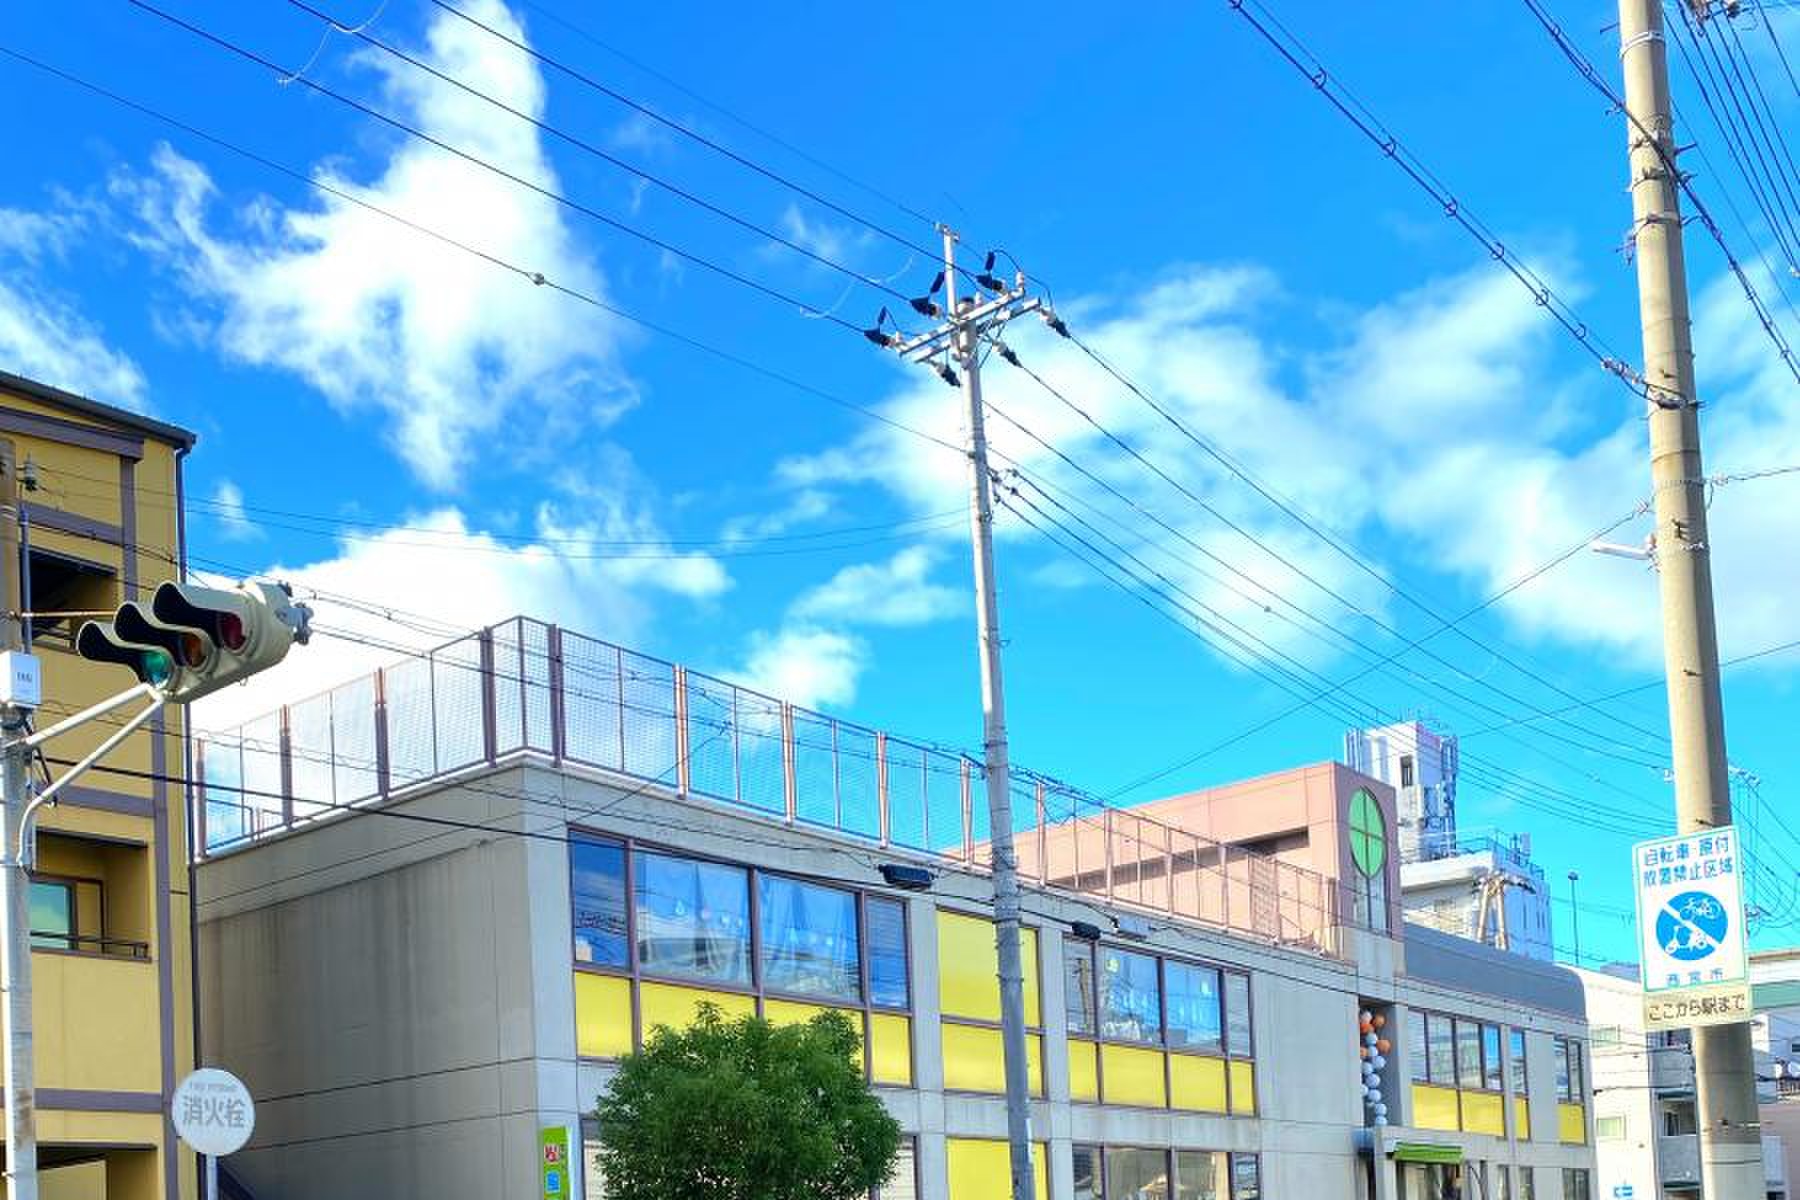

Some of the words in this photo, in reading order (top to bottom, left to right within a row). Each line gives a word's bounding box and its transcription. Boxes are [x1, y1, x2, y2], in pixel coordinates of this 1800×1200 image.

[1649, 994, 1744, 1021] ここから駅まで
[183, 1095, 245, 1128] 消火栓
